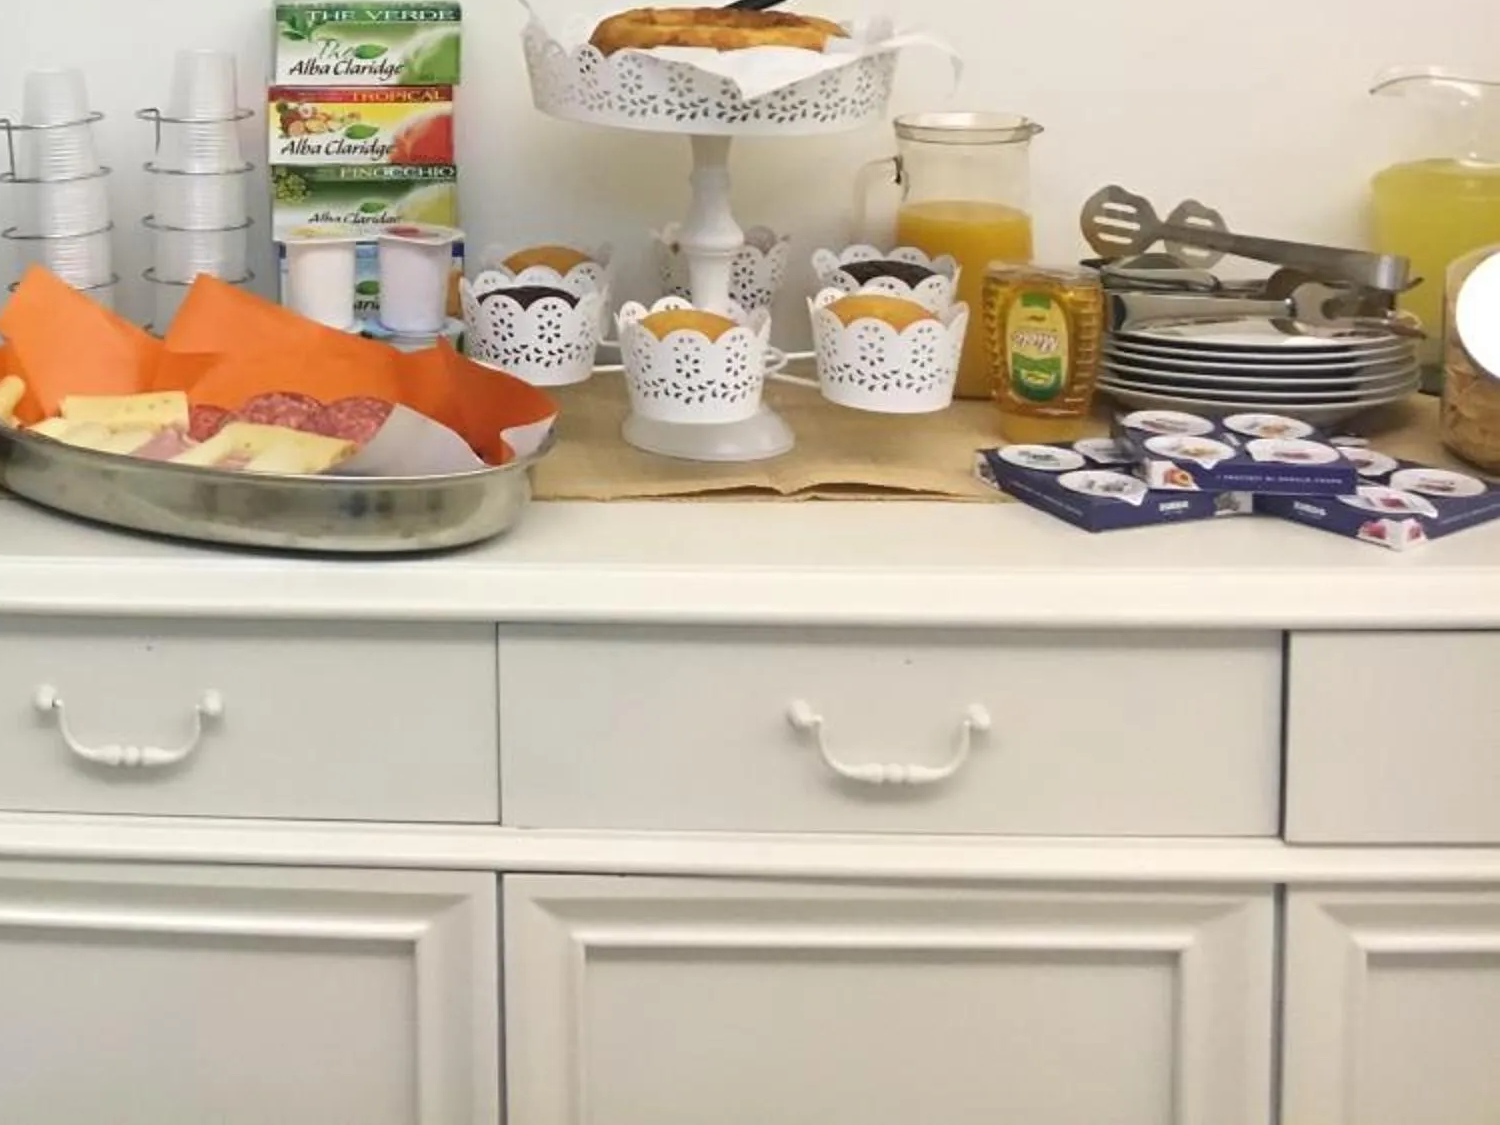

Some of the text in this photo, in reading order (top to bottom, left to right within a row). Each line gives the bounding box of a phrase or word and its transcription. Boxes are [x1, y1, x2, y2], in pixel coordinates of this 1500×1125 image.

[366, 10, 455, 21] VERDE
[289, 59, 405, 82] Alba Claridge
[352, 90, 444, 102] TROPICAL
[280, 139, 396, 162] Alba Claridge
[308, 211, 342, 225] Alba
